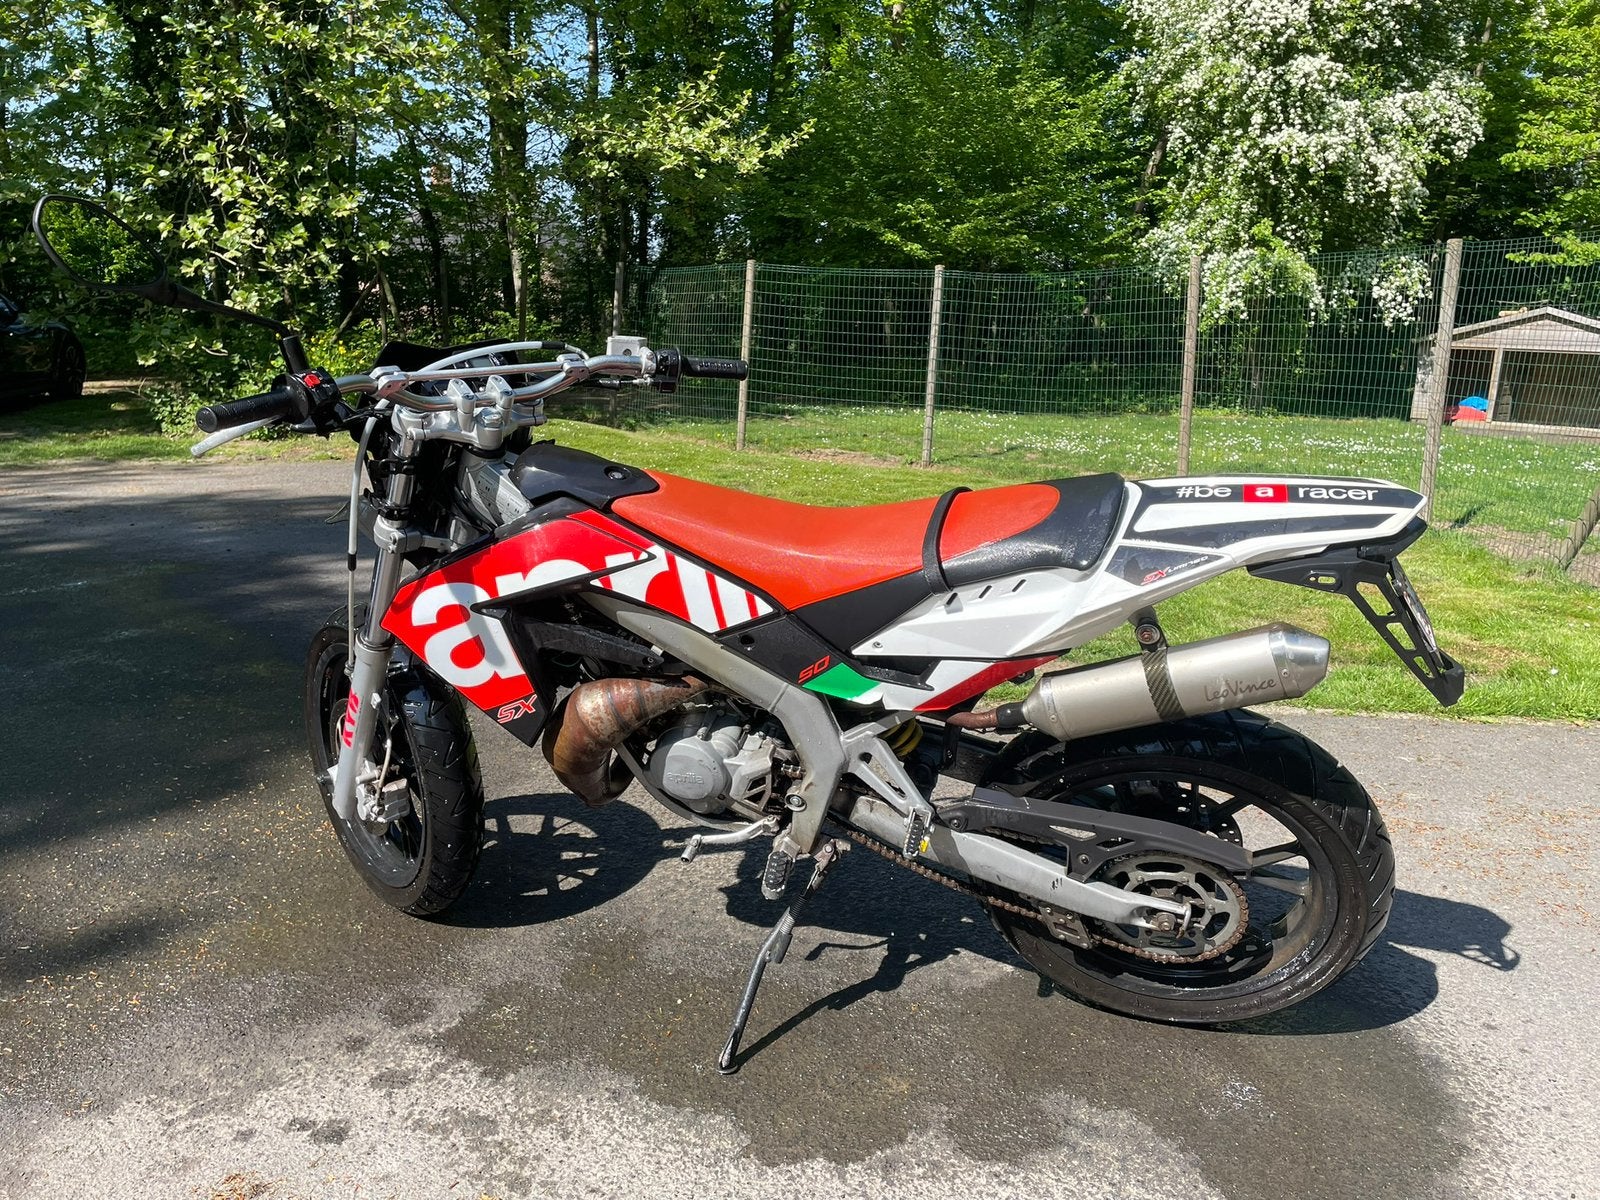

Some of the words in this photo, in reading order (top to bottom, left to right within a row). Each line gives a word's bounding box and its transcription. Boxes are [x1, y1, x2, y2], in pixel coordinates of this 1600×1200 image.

[1176, 485, 1232, 498] #be
[1255, 486, 1275, 498] a
[1298, 486, 1379, 501] racer
[798, 655, 831, 685] 50
[1203, 679, 1277, 702] LeoVince
[497, 694, 538, 724] SX
